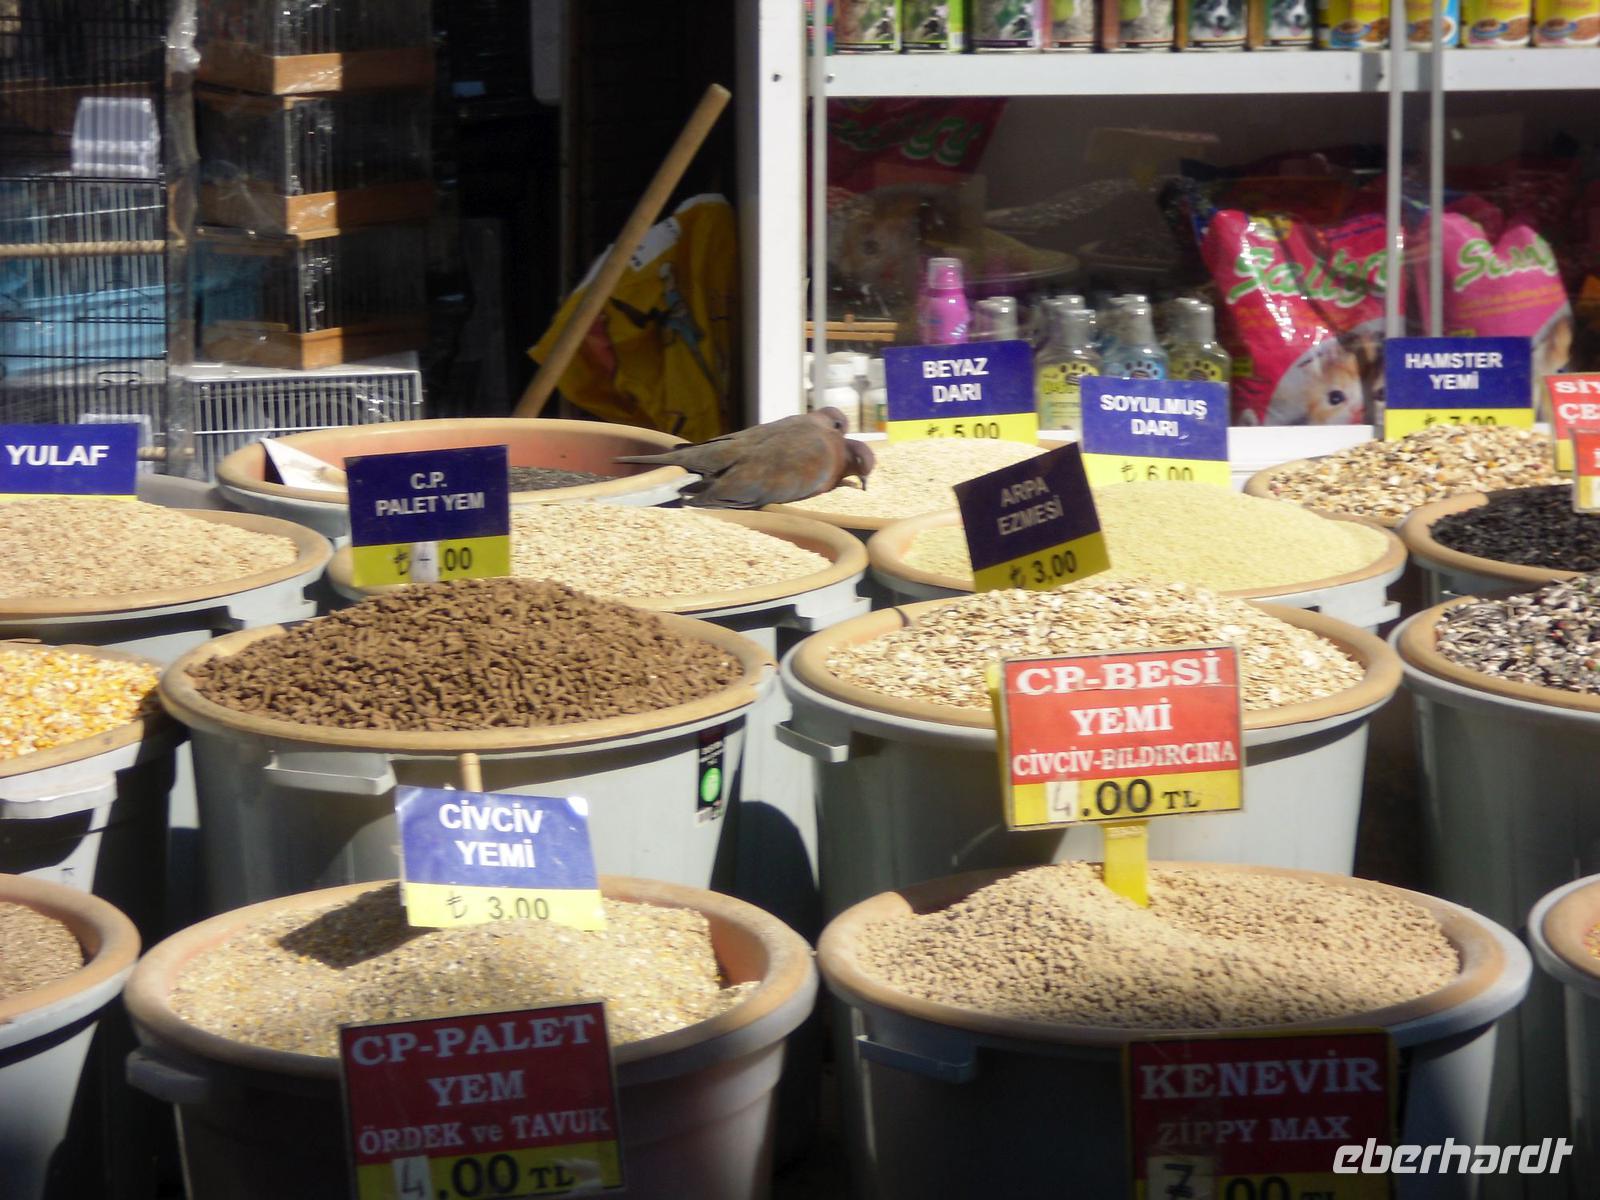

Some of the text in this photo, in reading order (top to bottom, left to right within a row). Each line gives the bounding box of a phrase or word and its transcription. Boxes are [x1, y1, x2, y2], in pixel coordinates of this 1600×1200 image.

[922, 357, 989, 379] BEYAZ
[1405, 352, 1503, 369] HAMSTER
[932, 383, 982, 403] DARI
[1429, 371, 1479, 390] YEMİ
[1100, 395, 1208, 420] SOYULMUŞ
[1131, 419, 1179, 437] DARI
[5, 444, 109, 467] YULAF
[410, 471, 448, 490] C.P.
[1001, 476, 1050, 507] ARPA
[375, 491, 485, 516] PALET YEM
[996, 495, 1064, 535] EZMESİ
[1015, 650, 1222, 696] CP-BESİ
[1070, 697, 1173, 736] YEMİ
[1162, 790, 1201, 810] TL
[438, 799, 544, 834] CİVCİV
[454, 839, 536, 868] YEMİ
[351, 1013, 596, 1066] CP-PALET
[427, 1069, 525, 1107] YEM
[1140, 1051, 1383, 1099] KENEVİR
[359, 1107, 611, 1155] ÖRDEK ve TAVUK
[1155, 1115, 1352, 1146] ZİPPY MAX
[528, 1166, 575, 1190] TL
